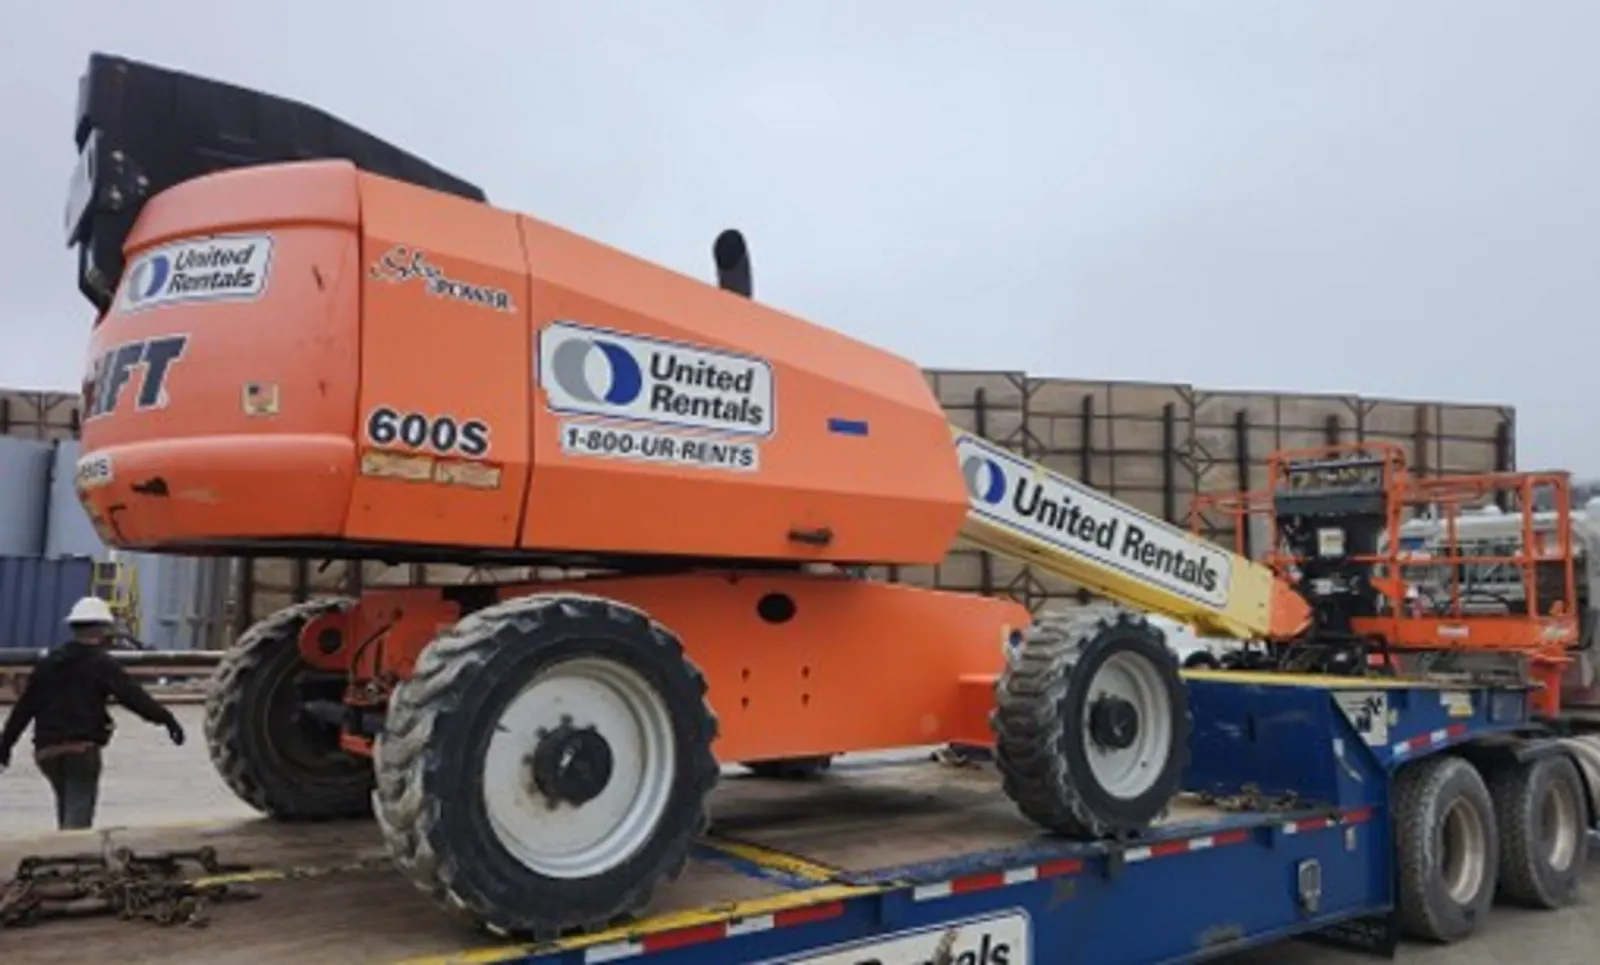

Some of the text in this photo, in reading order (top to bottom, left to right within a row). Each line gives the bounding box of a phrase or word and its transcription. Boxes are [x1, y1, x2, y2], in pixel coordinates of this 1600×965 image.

[173, 245, 254, 268] United
[168, 268, 254, 293] Rentals
[82, 335, 187, 418] IFT
[650, 352, 754, 393] United
[650, 384, 763, 426] Rentals
[368, 408, 488, 455] 600S
[1012, 477, 1218, 592] United Rentals
